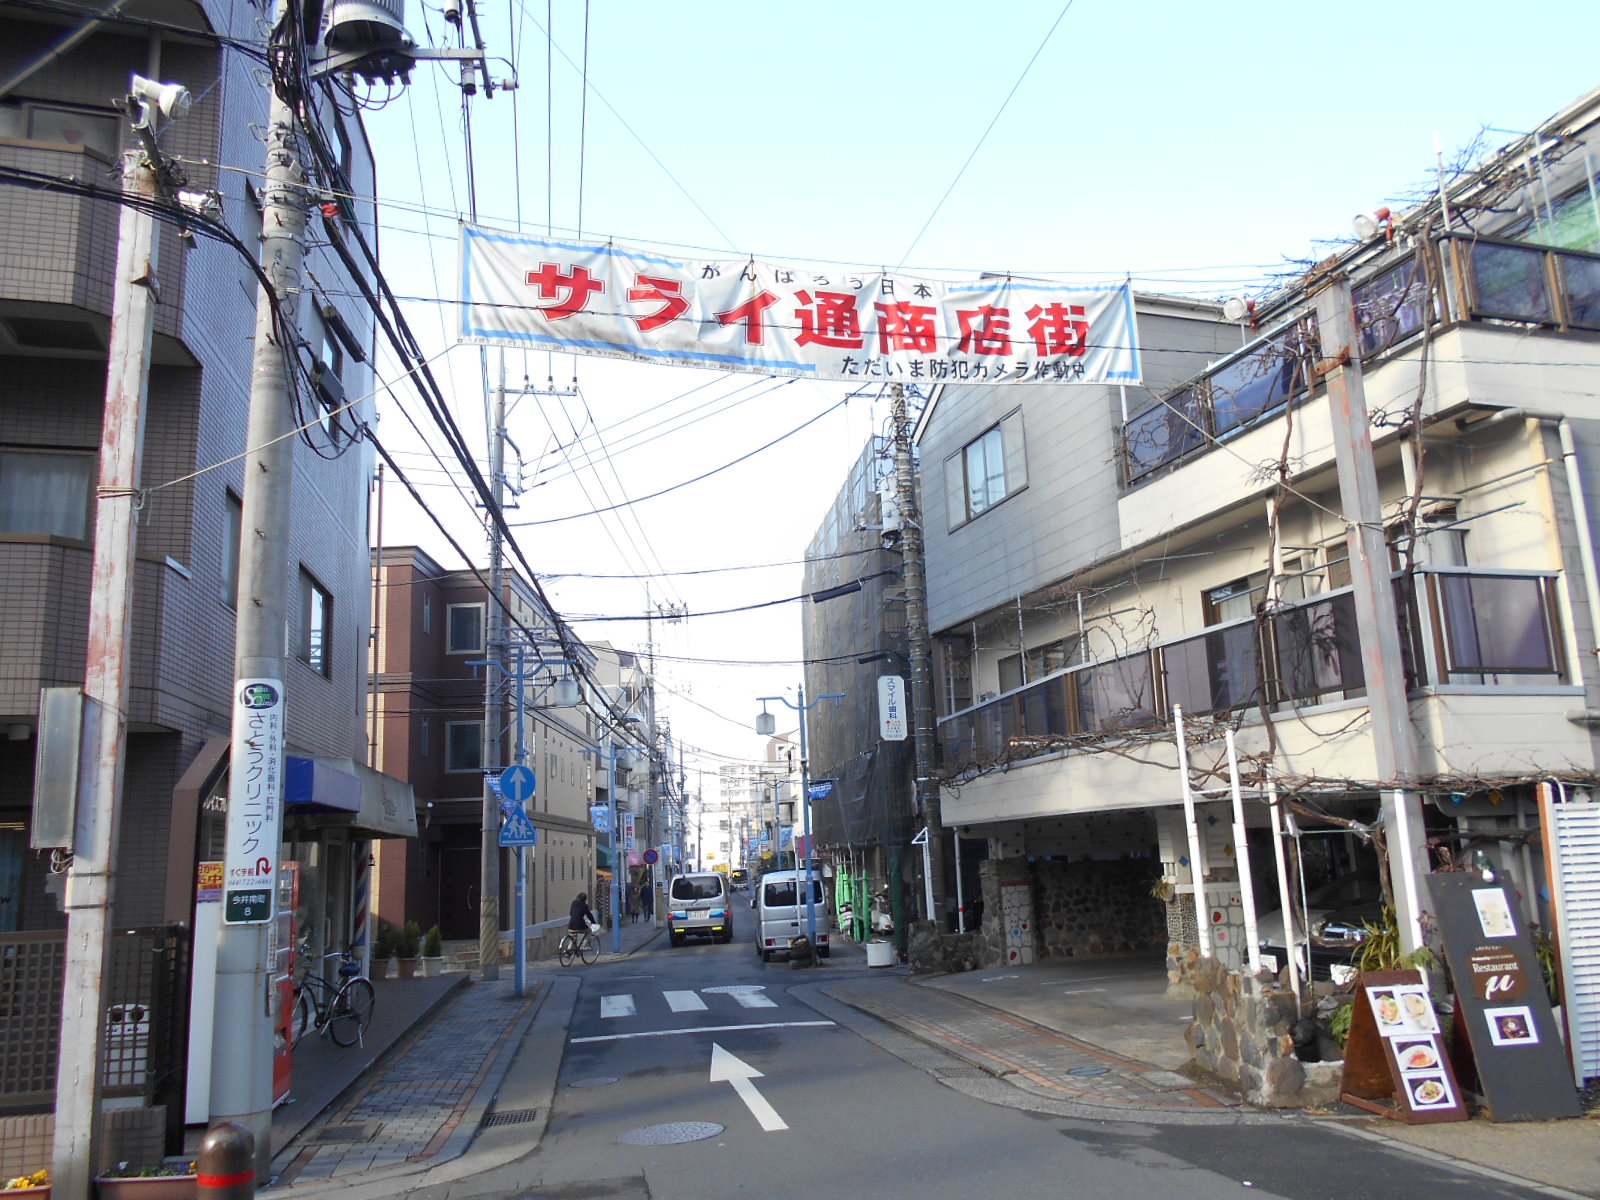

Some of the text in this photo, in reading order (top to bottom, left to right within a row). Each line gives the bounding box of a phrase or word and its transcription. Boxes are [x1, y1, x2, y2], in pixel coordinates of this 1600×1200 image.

[701, 263, 932, 300] がんばろう日本
[524, 261, 1091, 358] サライ通商店街
[841, 355, 1086, 381] ただいま防犯カメラ作動中
[886, 677, 898, 720] スマイル歯科
[242, 712, 266, 854] さとうクリニック
[244, 906, 252, 916] 8
[1471, 961, 1519, 974] Restaurant
